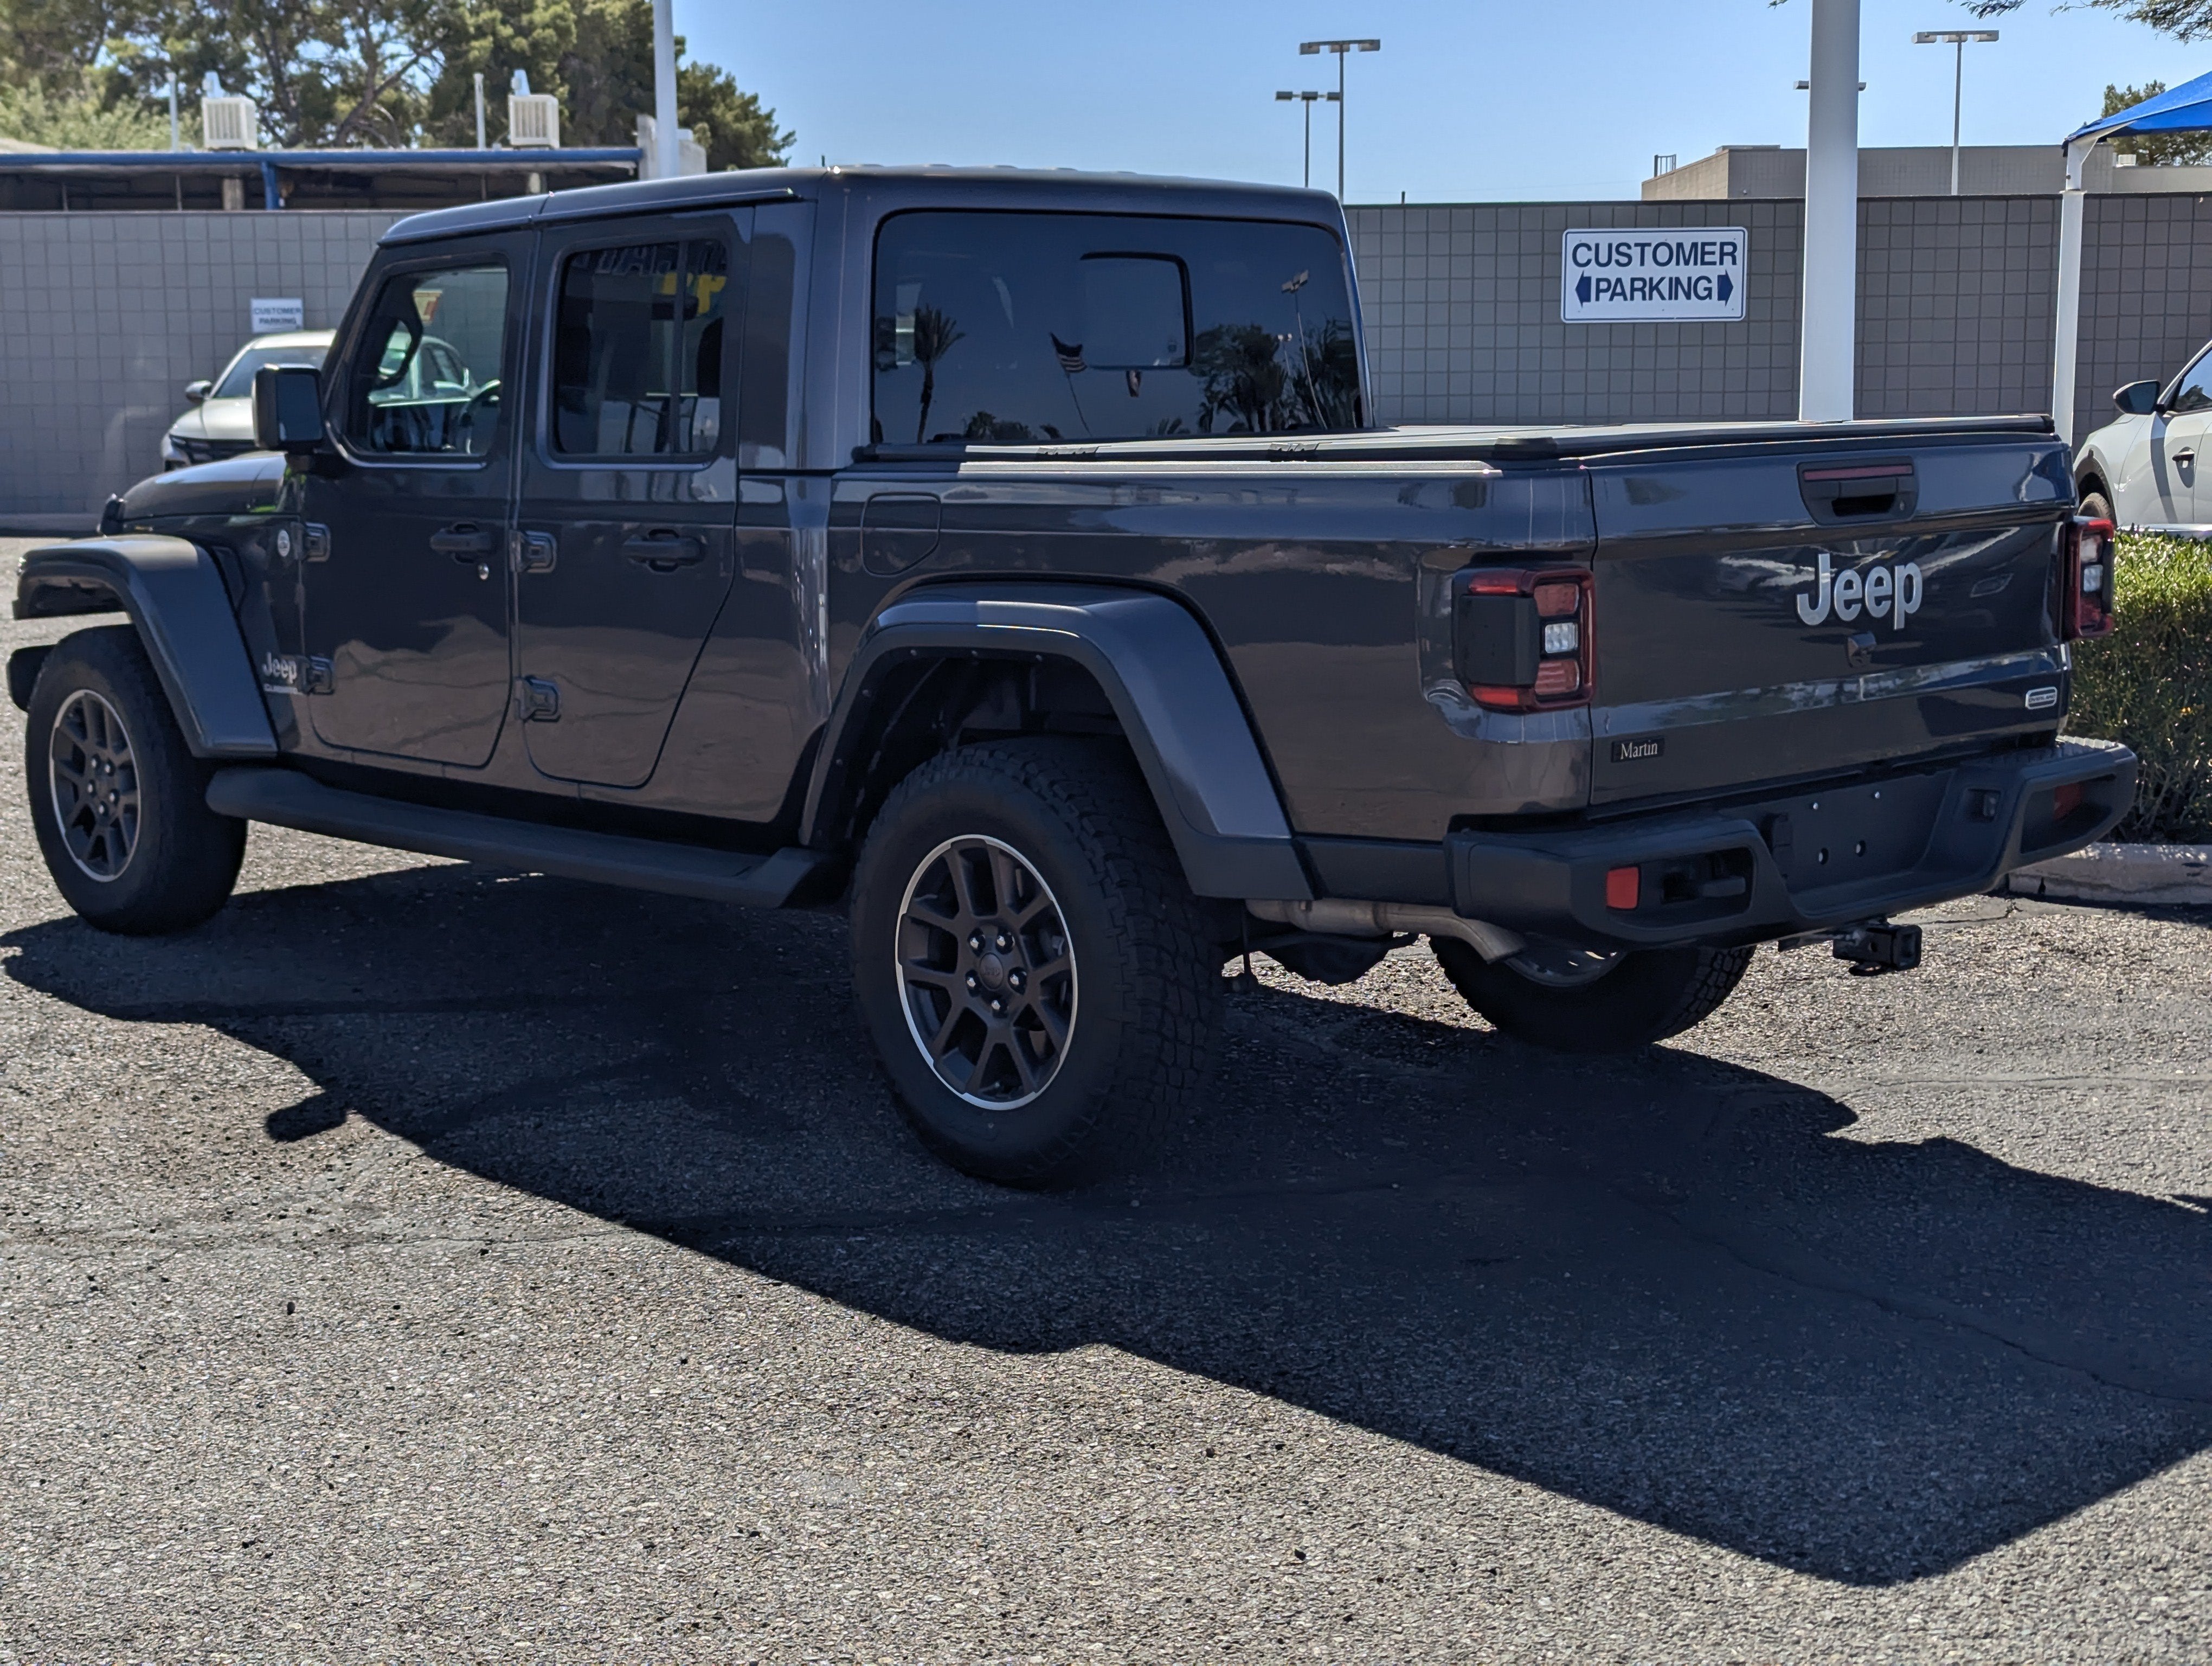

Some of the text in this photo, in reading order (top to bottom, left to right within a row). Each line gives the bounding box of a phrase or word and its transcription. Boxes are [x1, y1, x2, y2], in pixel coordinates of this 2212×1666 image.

[1572, 241, 1738, 267] CUSTOMER
[1594, 275, 1713, 302] PARKING
[1796, 553, 1922, 630] Jeep
[262, 652, 297, 684] Jeep
[1620, 740, 1658, 759] Martin
